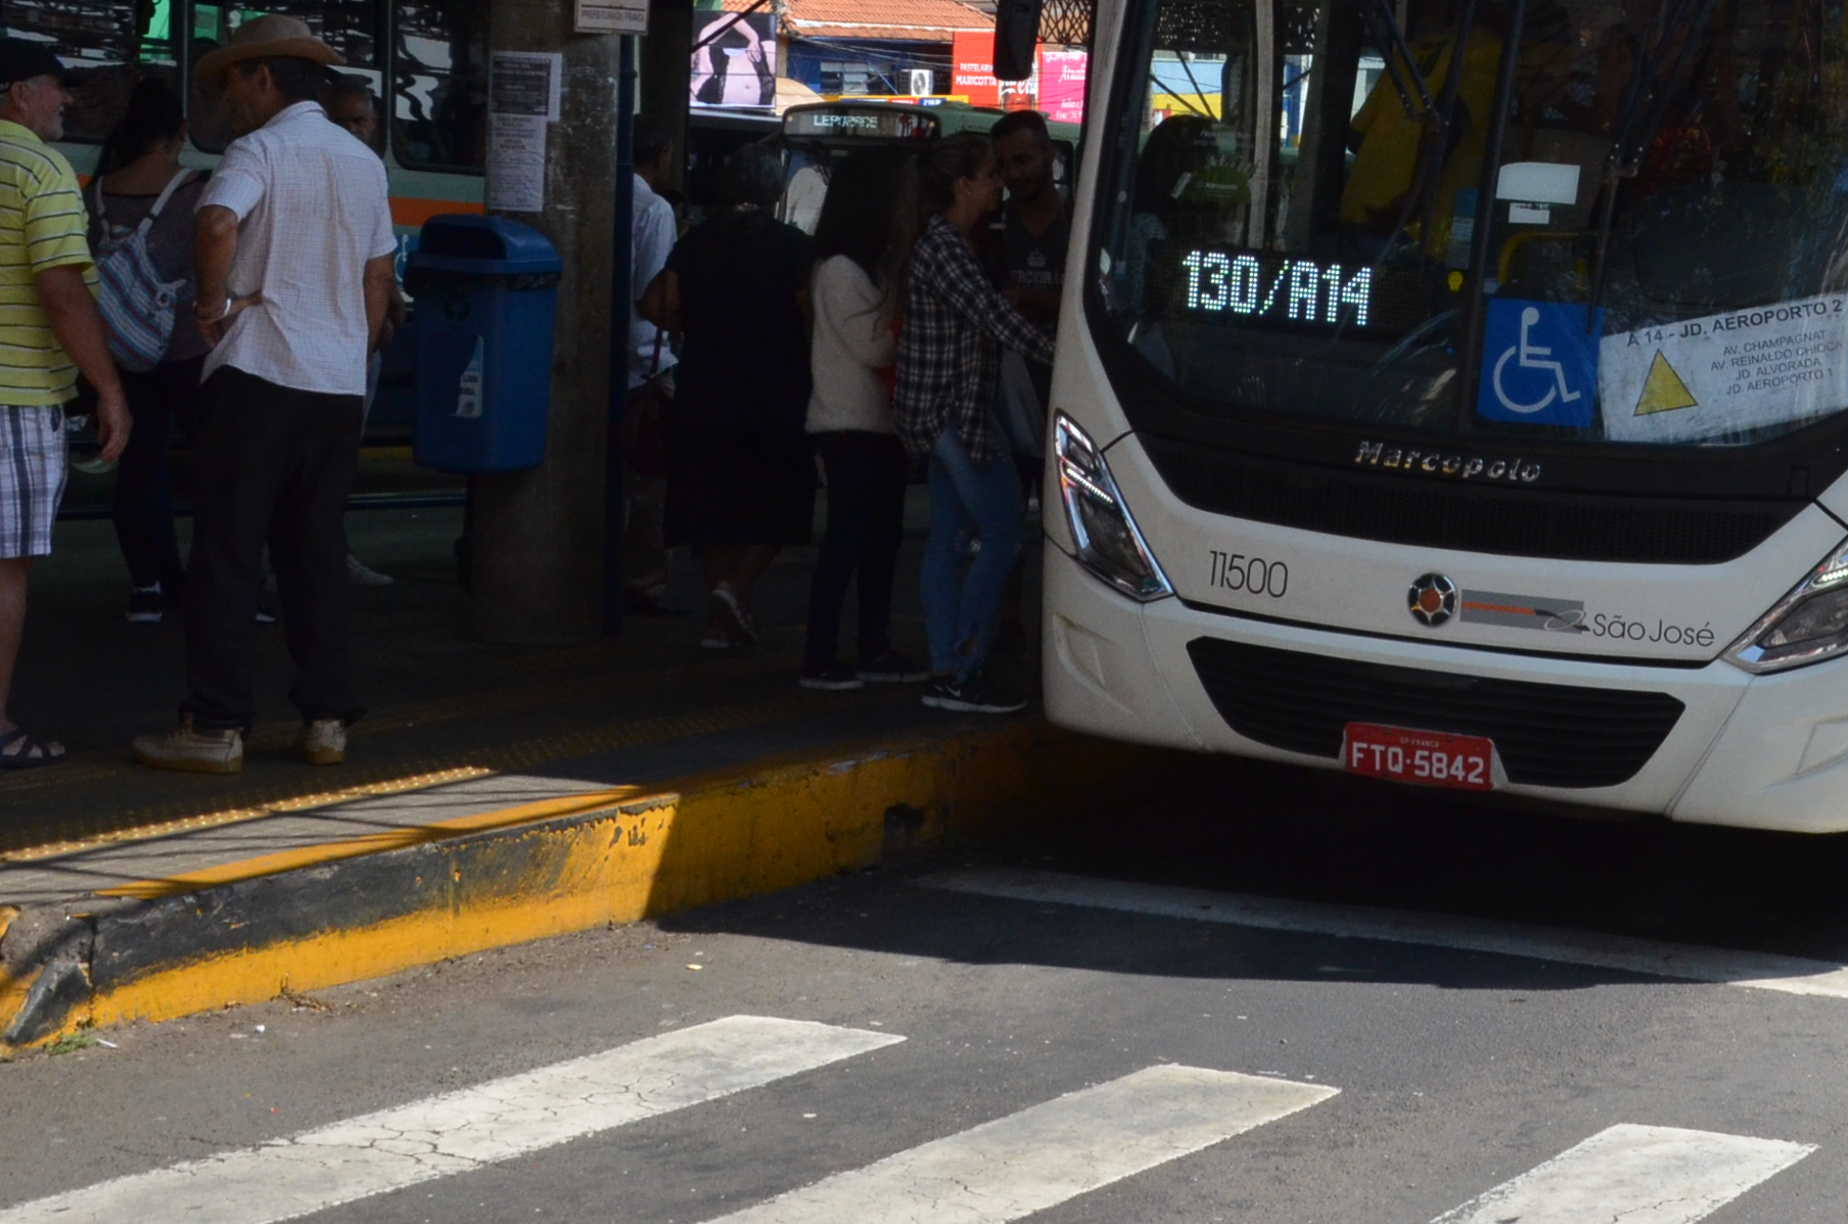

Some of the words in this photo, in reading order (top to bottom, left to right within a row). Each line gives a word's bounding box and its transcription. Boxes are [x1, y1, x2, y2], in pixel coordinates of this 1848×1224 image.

[955, 76, 997, 87] MARICOTTA
[1182, 250, 1372, 326] 130/A14
[1626, 335, 1639, 348] A
[1645, 330, 1664, 345] 14
[1680, 322, 1708, 339] JD.
[1712, 301, 1828, 333] AEROPORTO
[1833, 299, 1843, 313] 2
[1723, 346, 1741, 357] AV.
[1744, 330, 1826, 354] CHAMPAGNAT
[1710, 360, 1728, 371] AV.
[1731, 349, 1793, 368] REINALDO
[1735, 369, 1751, 381] JD.
[1755, 358, 1822, 377] ALVORADA
[1726, 384, 1744, 396] JD.
[1747, 371, 1824, 391] AEROPORTO
[1354, 441, 1541, 483] Marcopolo
[1209, 550, 1288, 598] 11500
[1592, 613, 1646, 641] São
[1648, 619, 1715, 647] José
